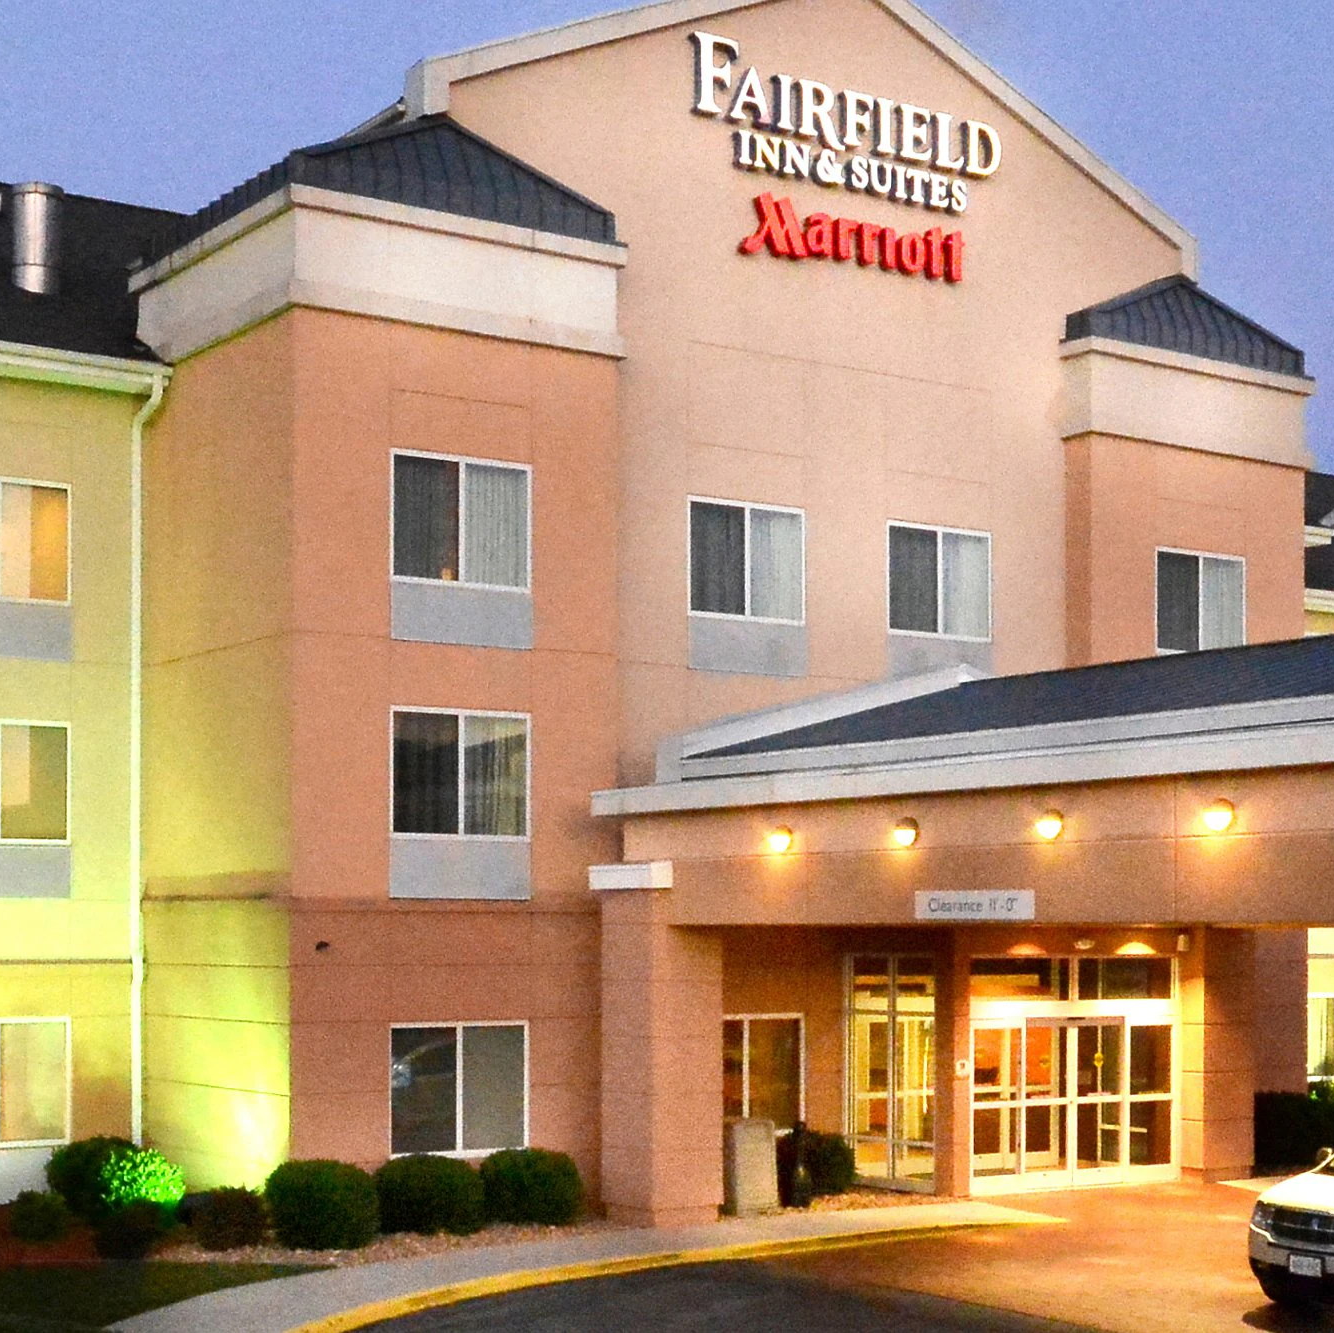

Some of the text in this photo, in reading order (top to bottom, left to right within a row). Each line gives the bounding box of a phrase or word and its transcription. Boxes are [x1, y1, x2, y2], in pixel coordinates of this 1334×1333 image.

[690, 30, 1003, 178] FAIRFIELD
[736, 130, 812, 178] INN
[851, 155, 969, 212] SUITES
[738, 191, 966, 283] Marriott
[928, 897, 983, 912] Clearance
